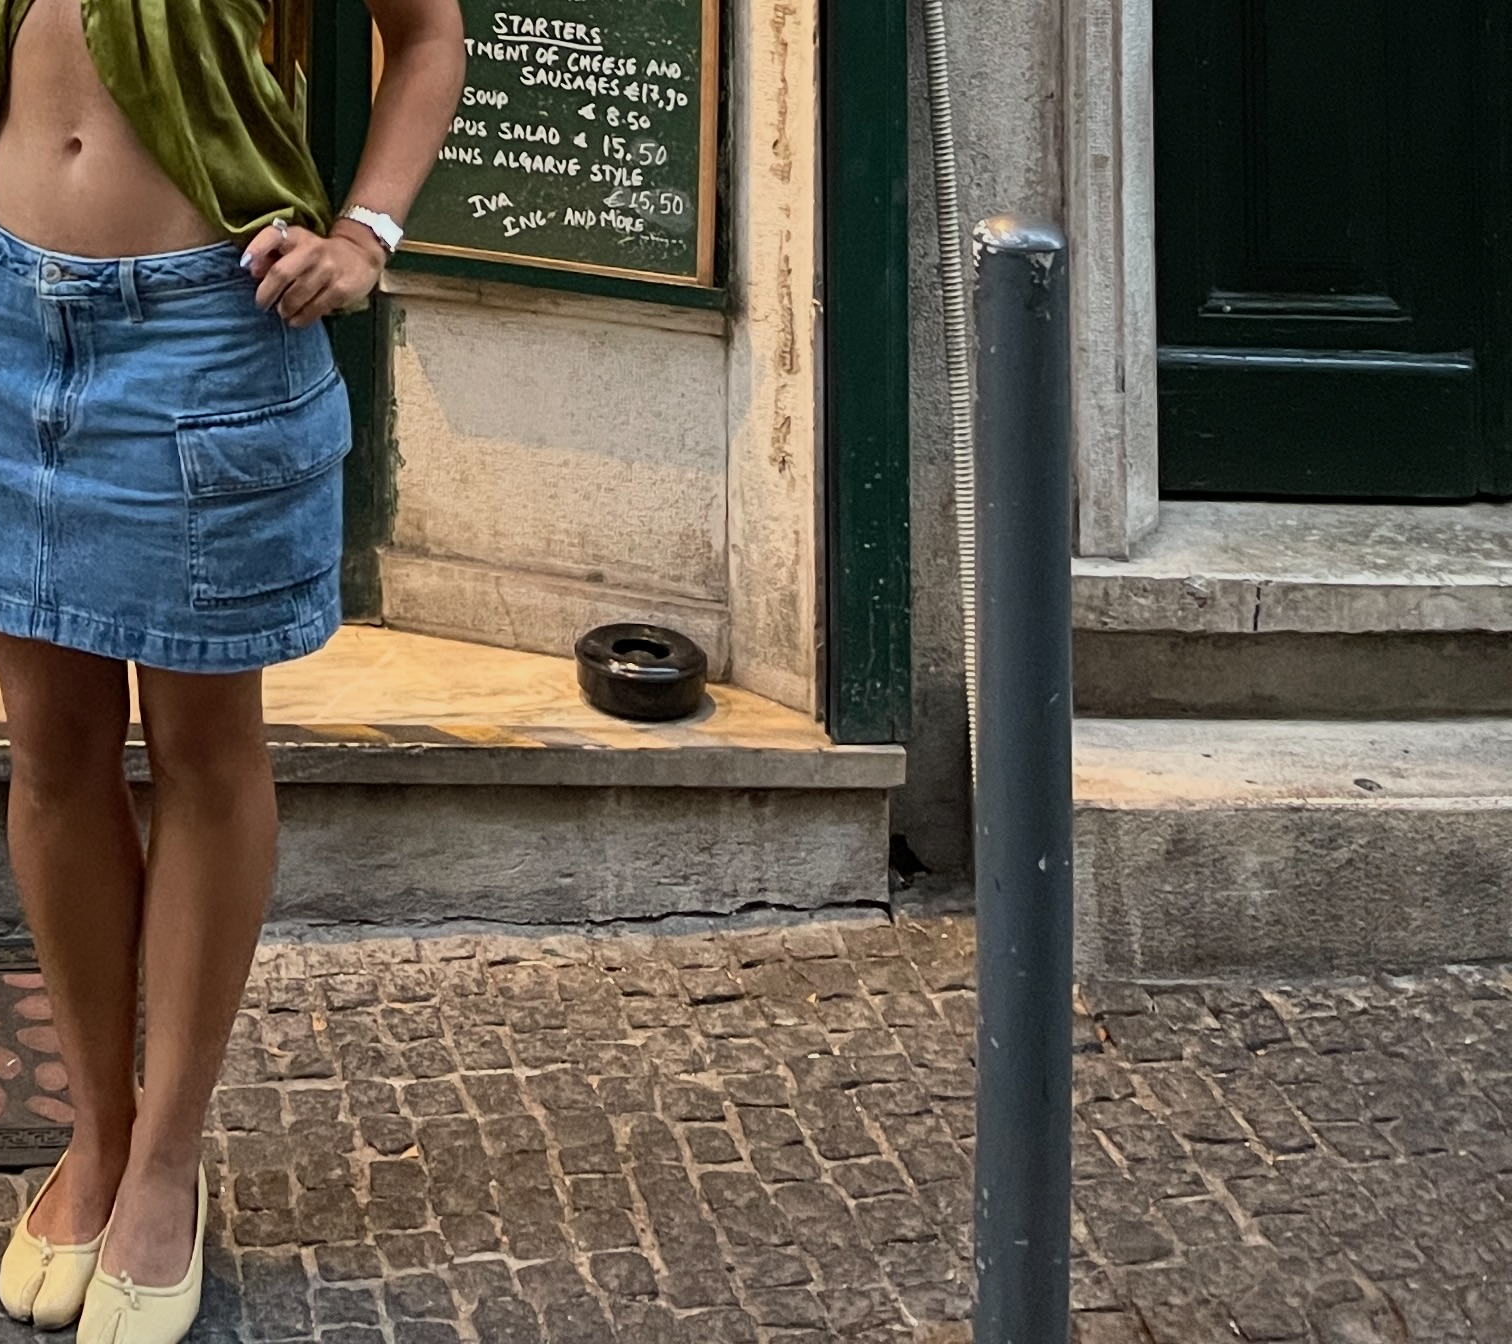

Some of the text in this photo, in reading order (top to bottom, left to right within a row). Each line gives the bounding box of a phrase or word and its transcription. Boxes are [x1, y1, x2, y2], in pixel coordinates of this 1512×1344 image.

[492, 12, 602, 45] STARTERS
[464, 38, 682, 79] TMENT OF CHEESE AND
[519, 65, 620, 97] SAUSAGES
[462, 86, 509, 110] SOUP
[448, 116, 487, 137] PUS
[497, 121, 561, 145] SALAD
[493, 150, 581, 176] ALGARVE
[589, 163, 644, 186] STYLE
[467, 192, 514, 218] IVA
[563, 207, 596, 227] AND
